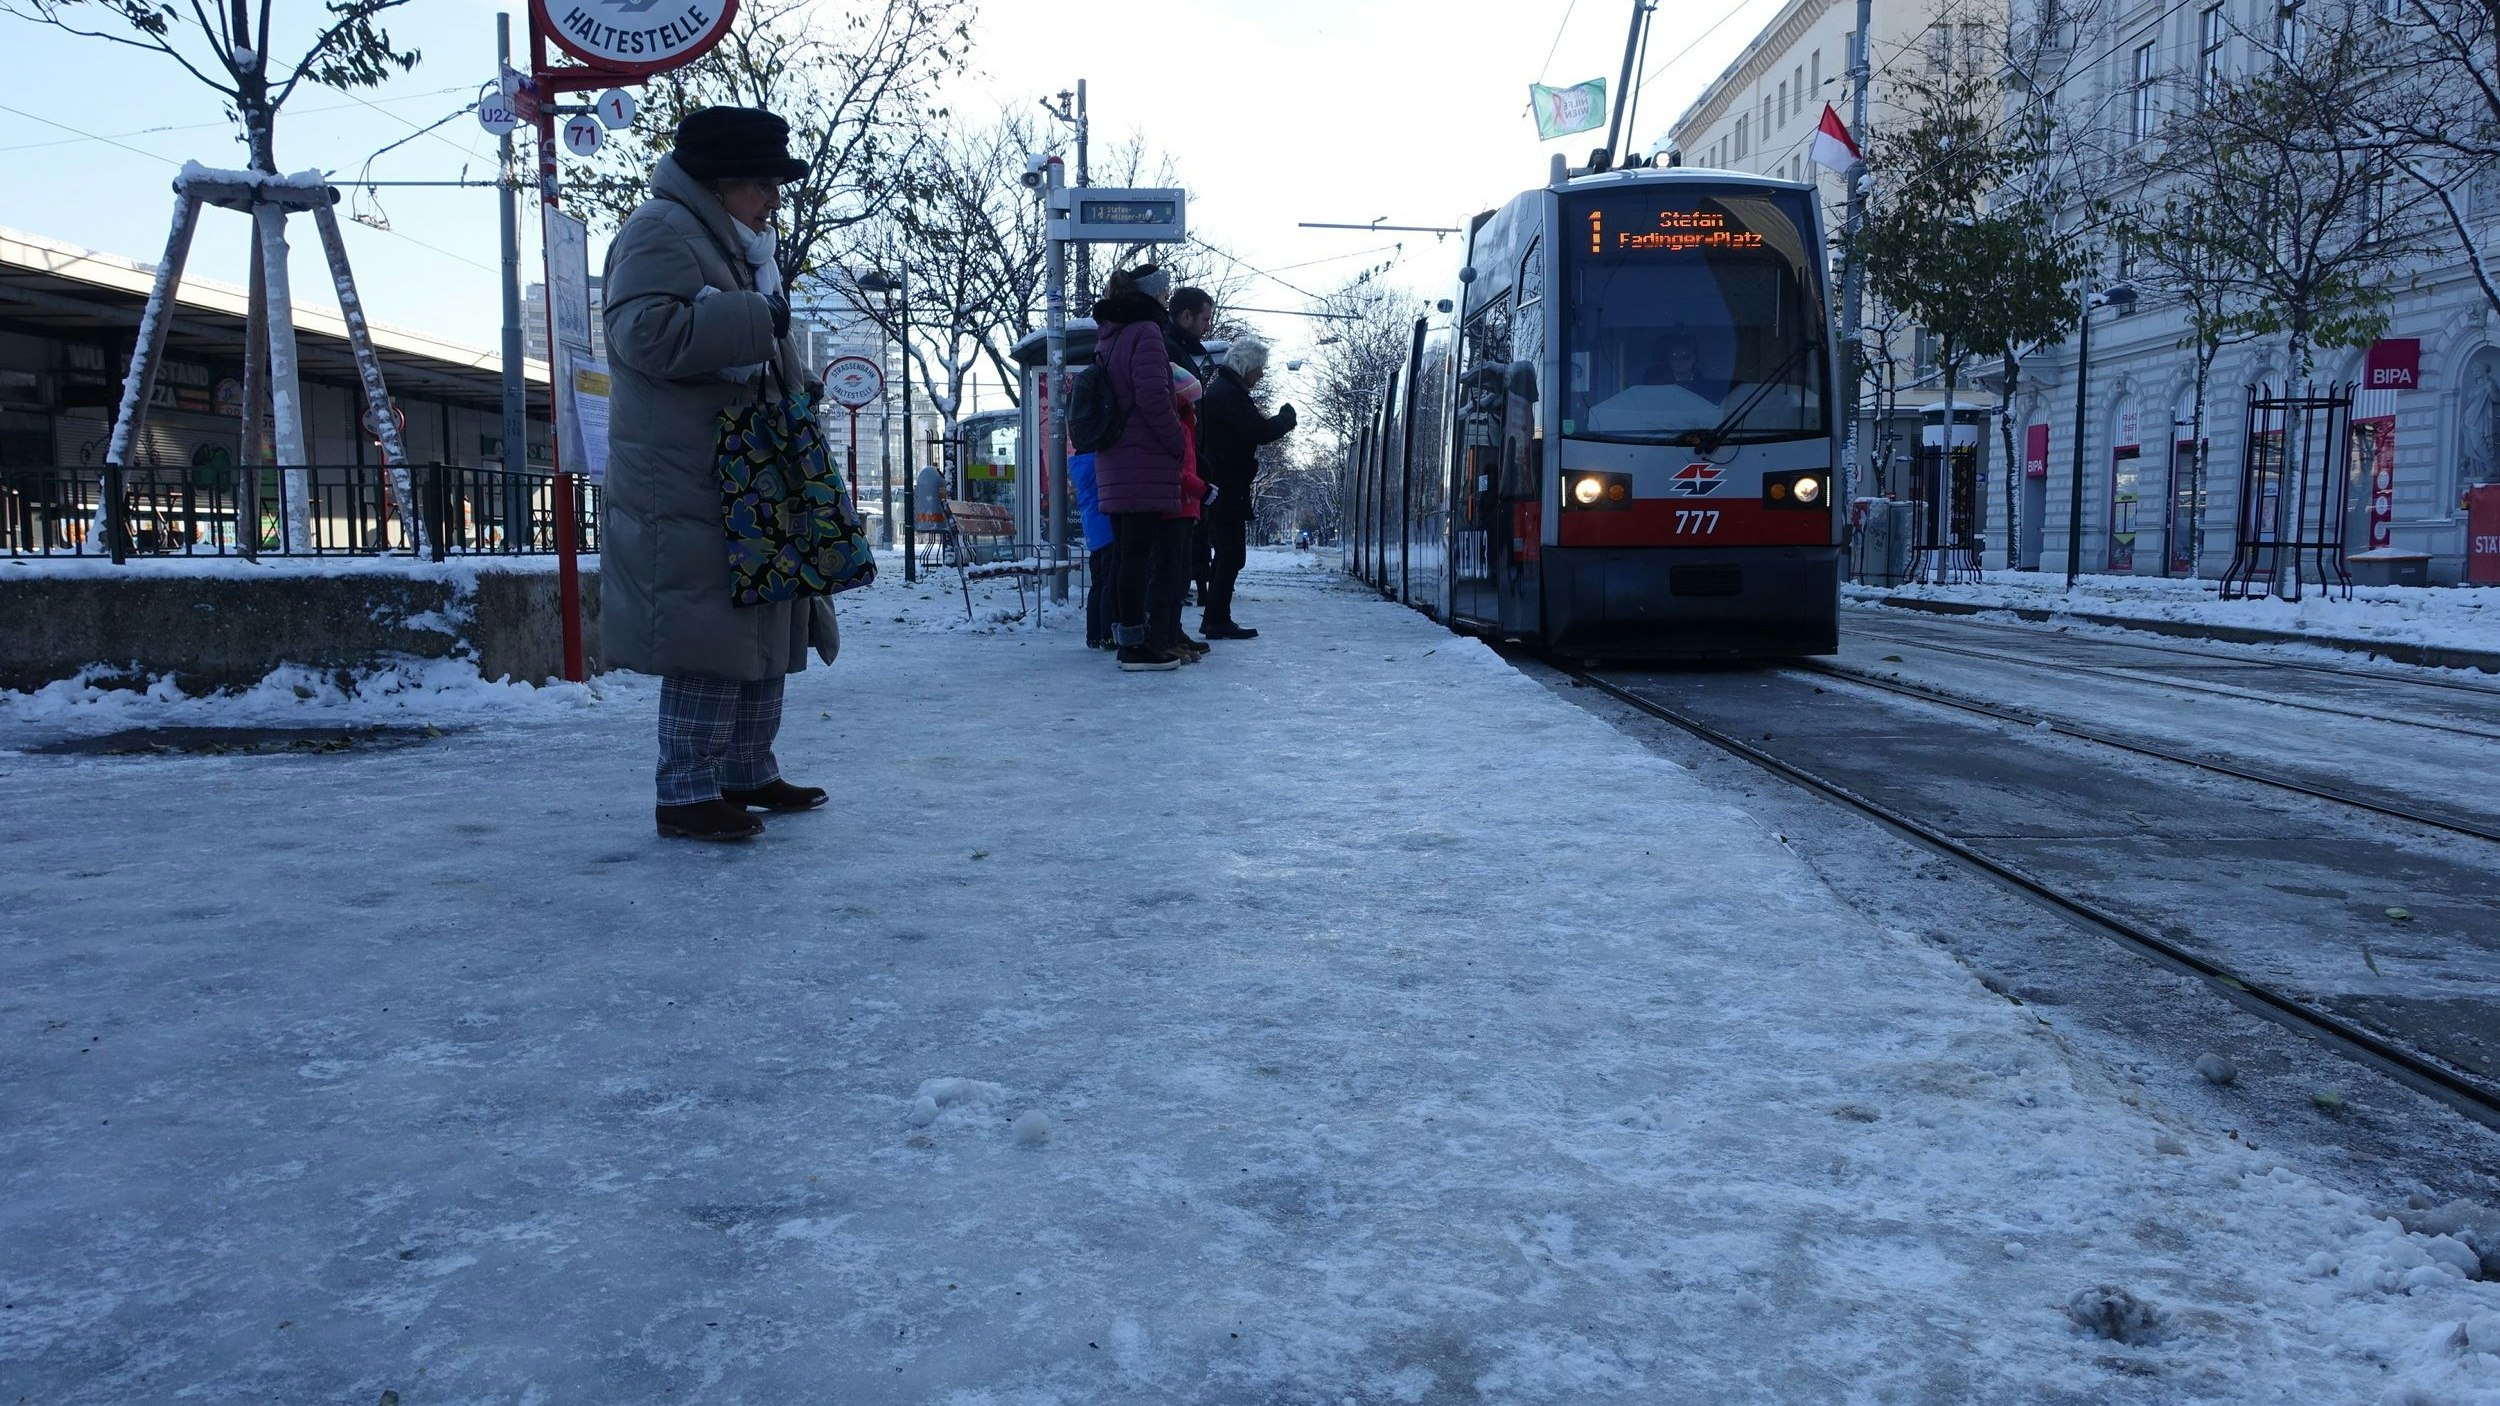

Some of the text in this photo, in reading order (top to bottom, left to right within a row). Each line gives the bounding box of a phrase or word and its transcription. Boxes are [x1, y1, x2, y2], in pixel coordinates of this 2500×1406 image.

[563, 5, 710, 54] HALTESTELLE
[611, 98, 623, 120] 1
[570, 126, 596, 146] 71
[1660, 211, 1724, 227] Stefan
[1589, 211, 1602, 253] 1
[1619, 231, 1763, 251] Fadinger-Platz
[831, 362, 876, 380] STRASSENBAHN
[2373, 368, 2412, 384] BIPA
[832, 384, 873, 399] HALTESTELLE
[2027, 460, 2043, 473] BIPA
[1675, 510, 1720, 534] 777
[1458, 529, 1488, 580] VENU 3
[2475, 535, 2500, 554] STÄ
